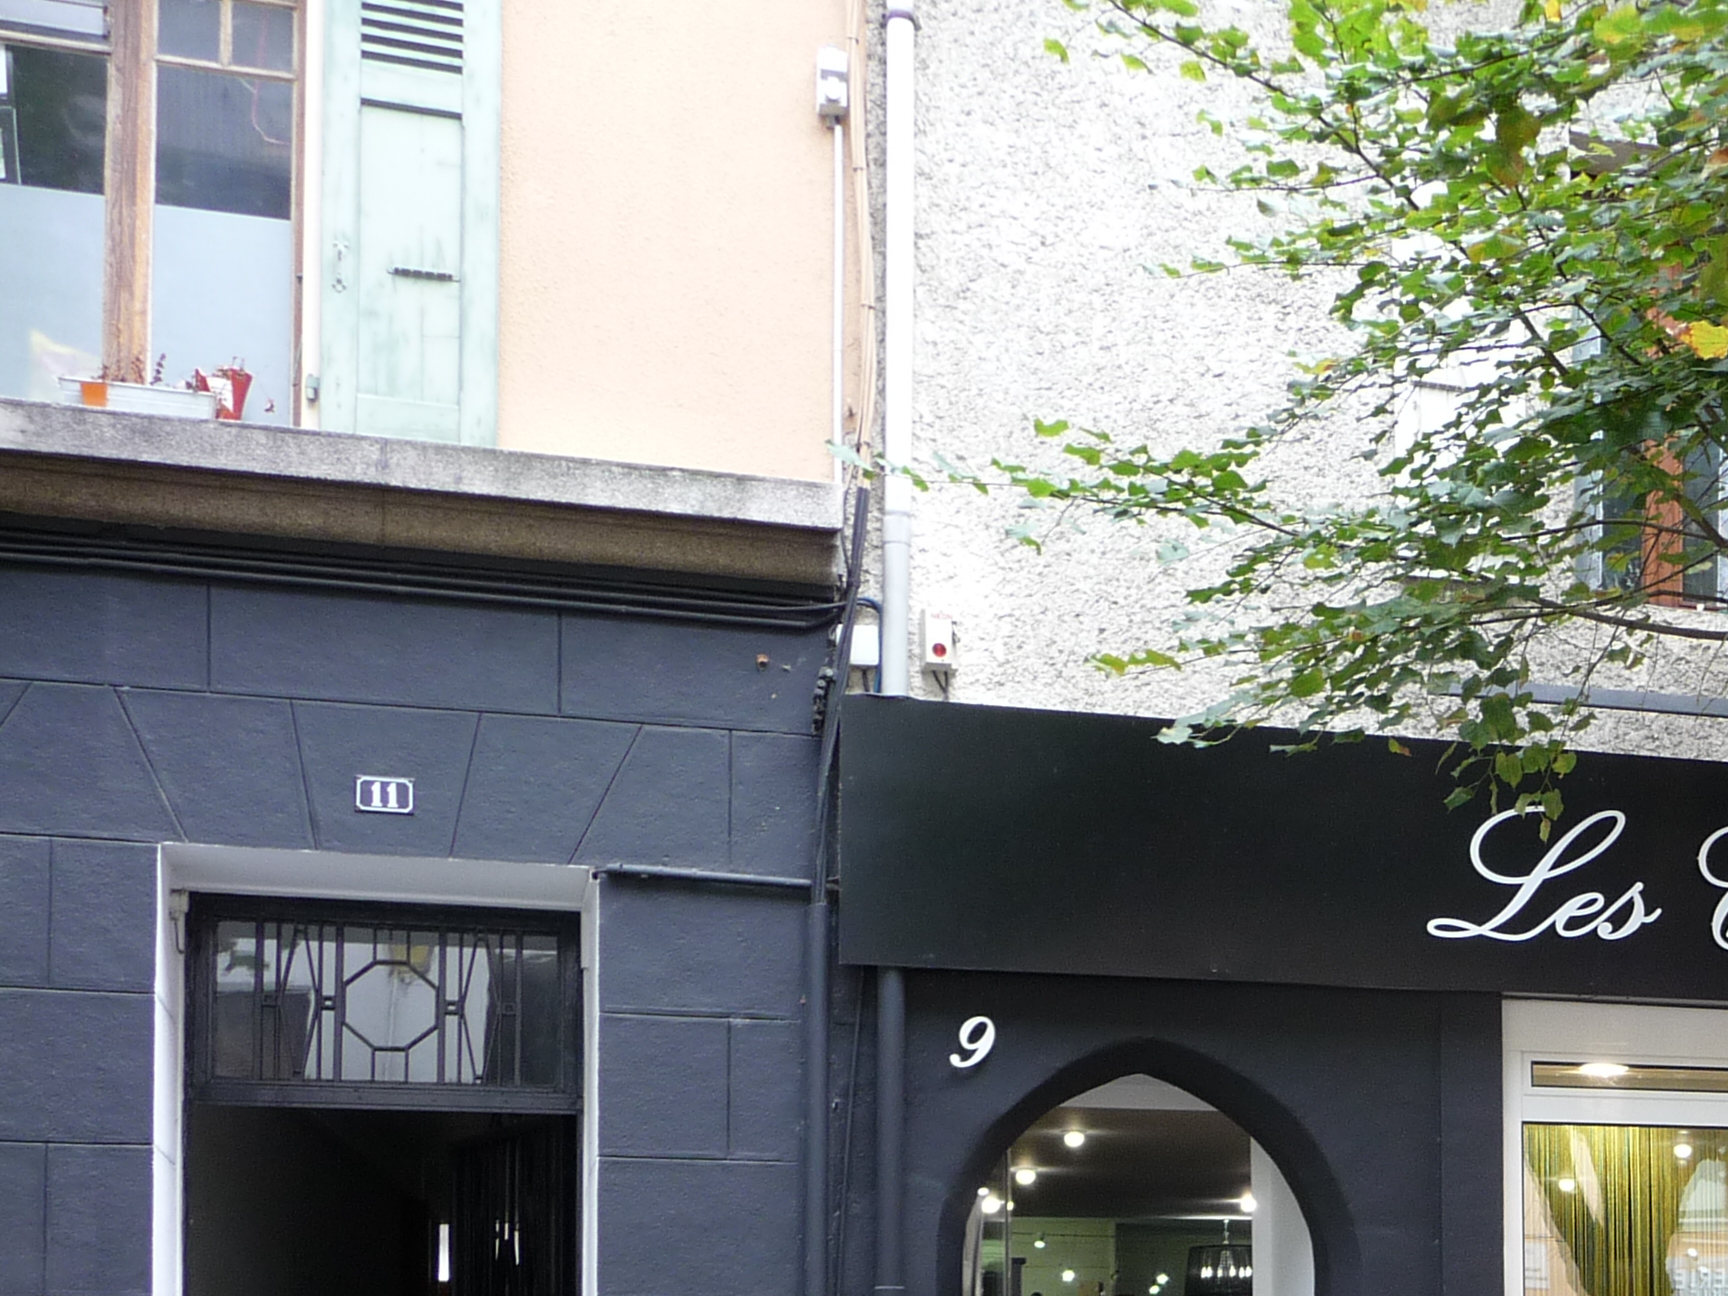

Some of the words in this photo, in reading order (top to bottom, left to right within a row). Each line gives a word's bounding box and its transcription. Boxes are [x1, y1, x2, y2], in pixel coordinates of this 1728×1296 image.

[371, 781, 399, 808] 11
[1426, 804, 1663, 942] Les
[948, 1015, 996, 1069] 9
